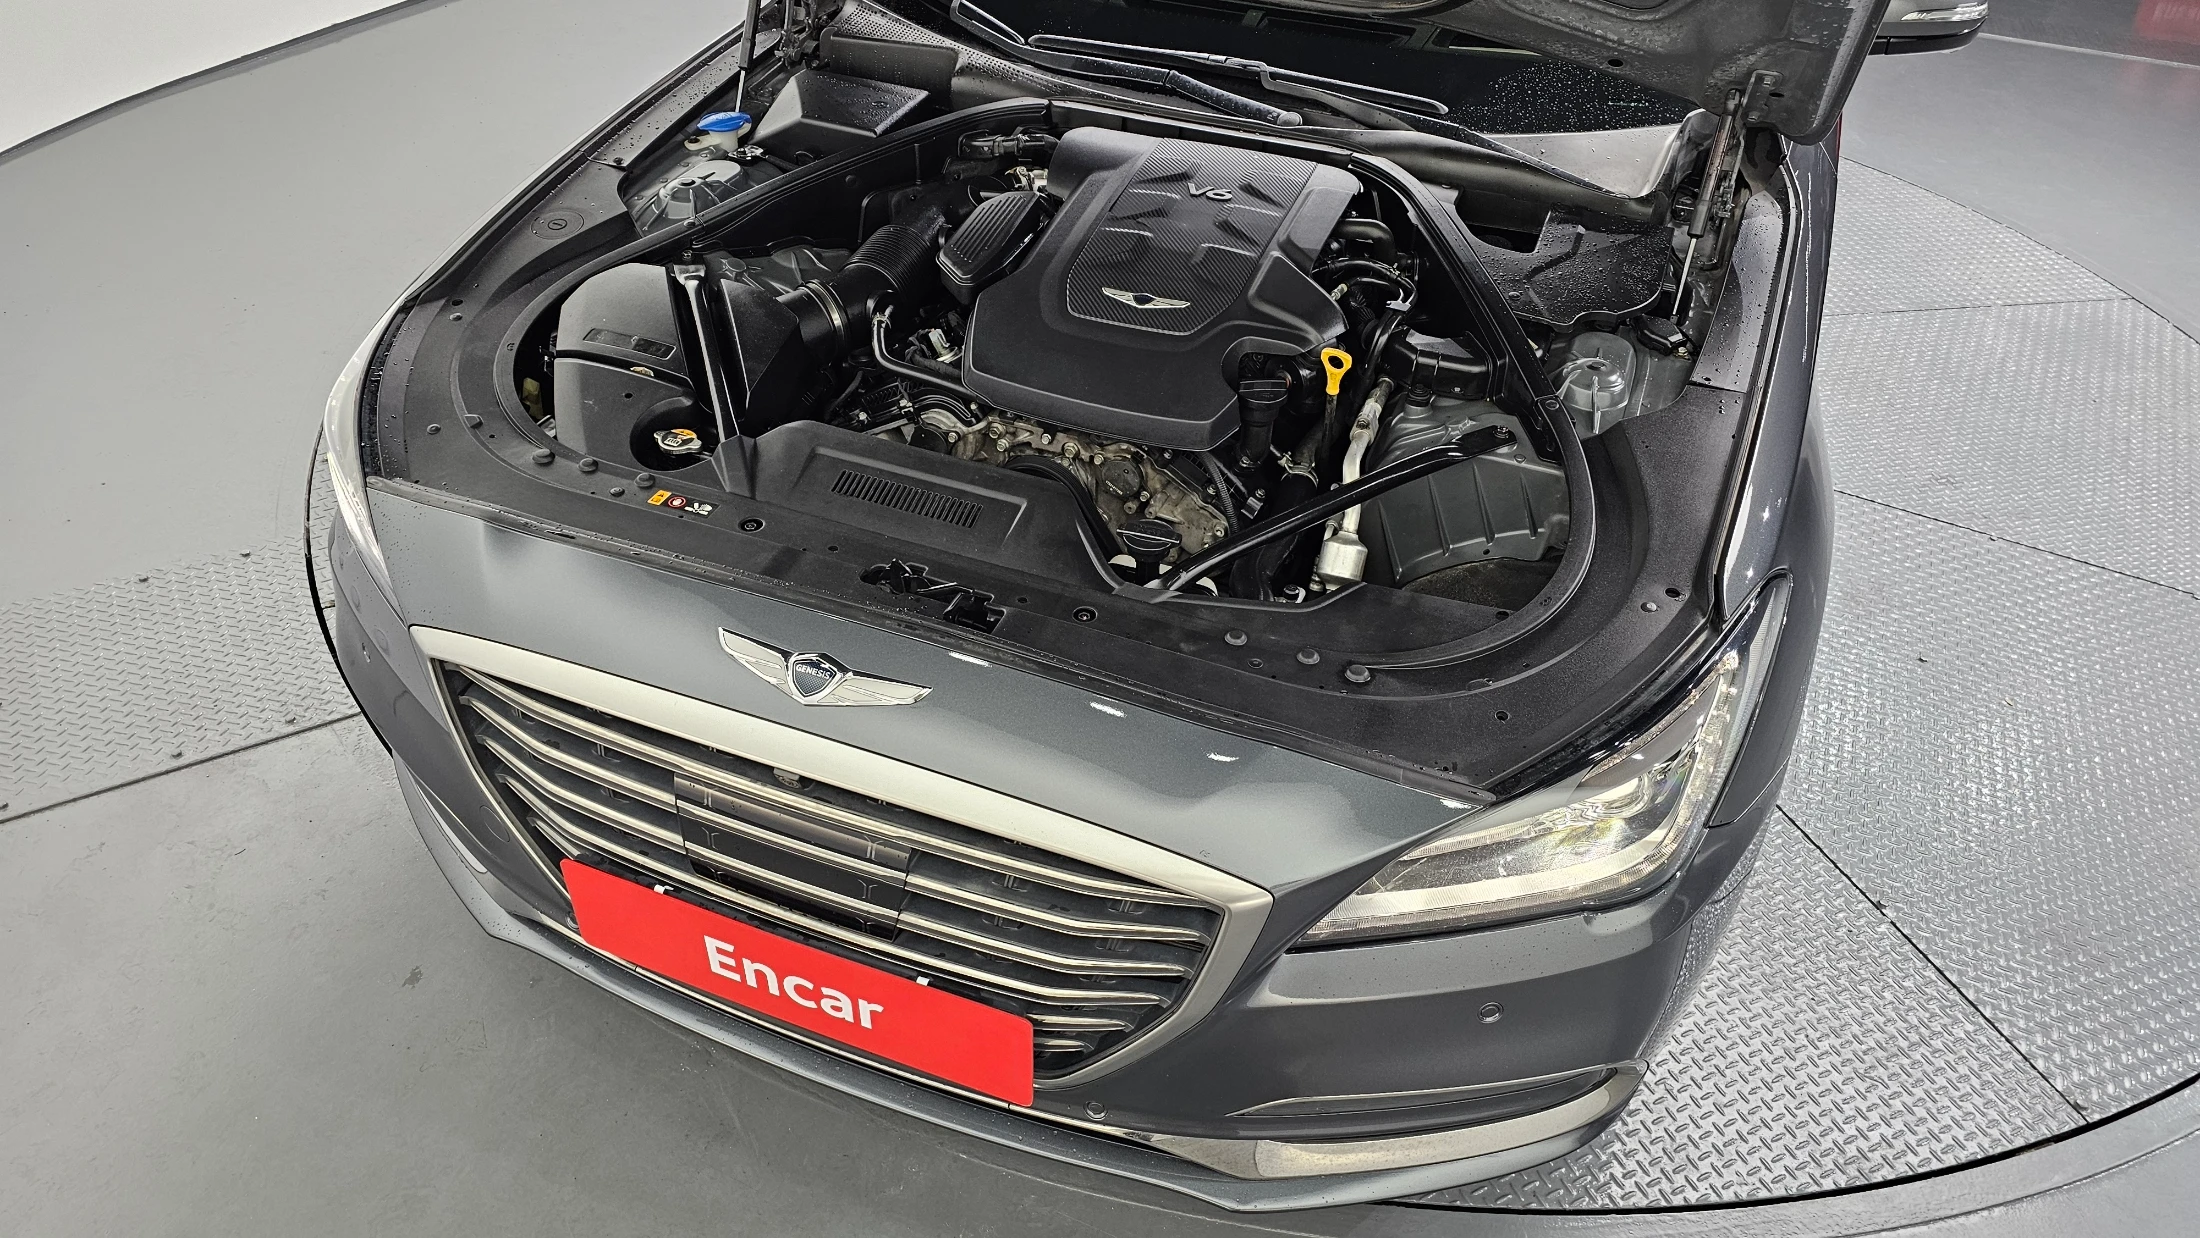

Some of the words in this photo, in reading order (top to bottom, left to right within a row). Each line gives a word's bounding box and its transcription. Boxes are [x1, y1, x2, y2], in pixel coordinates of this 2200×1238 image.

[1187, 182, 1233, 201] V6
[796, 663, 831, 680] GENESIS
[703, 934, 885, 1030] Encar
